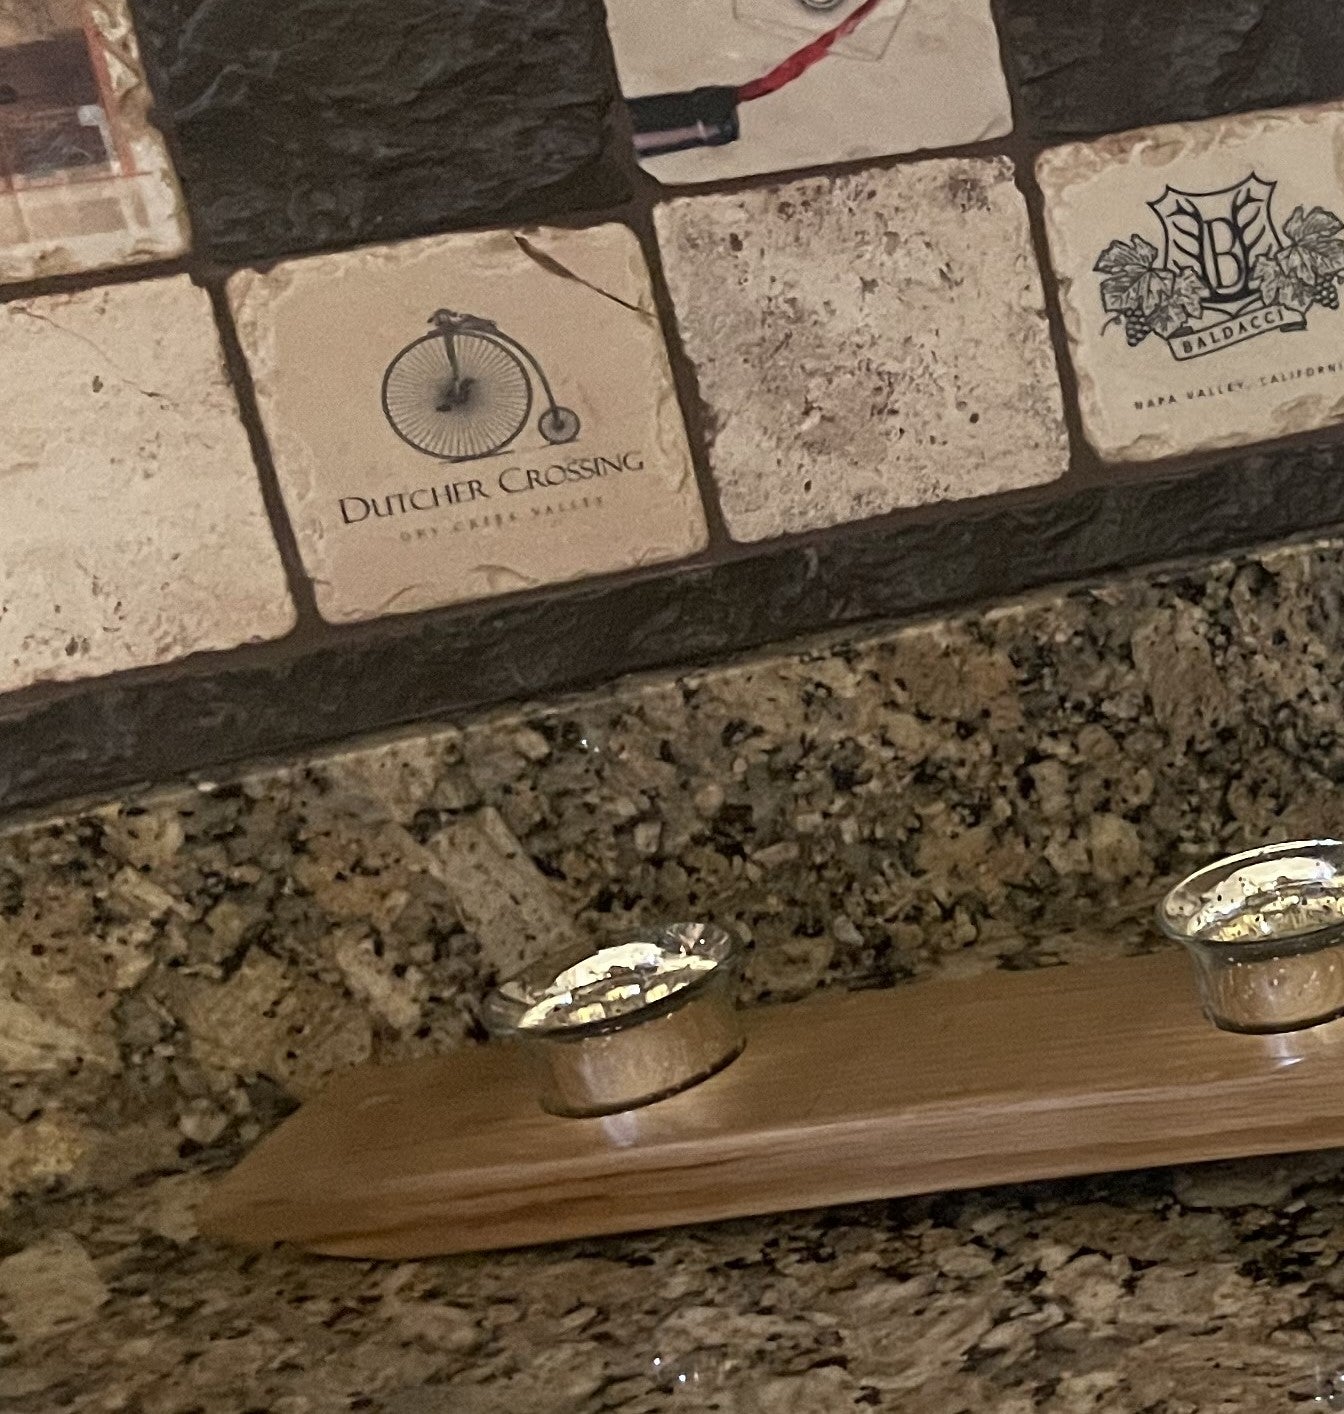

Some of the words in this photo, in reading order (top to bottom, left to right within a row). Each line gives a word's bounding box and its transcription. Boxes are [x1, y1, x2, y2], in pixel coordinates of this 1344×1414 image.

[1181, 308, 1285, 354] BALDACCI
[1134, 394, 1177, 410] NAPA
[338, 479, 490, 525] DUTCHER
[498, 450, 645, 494] CROSSING
